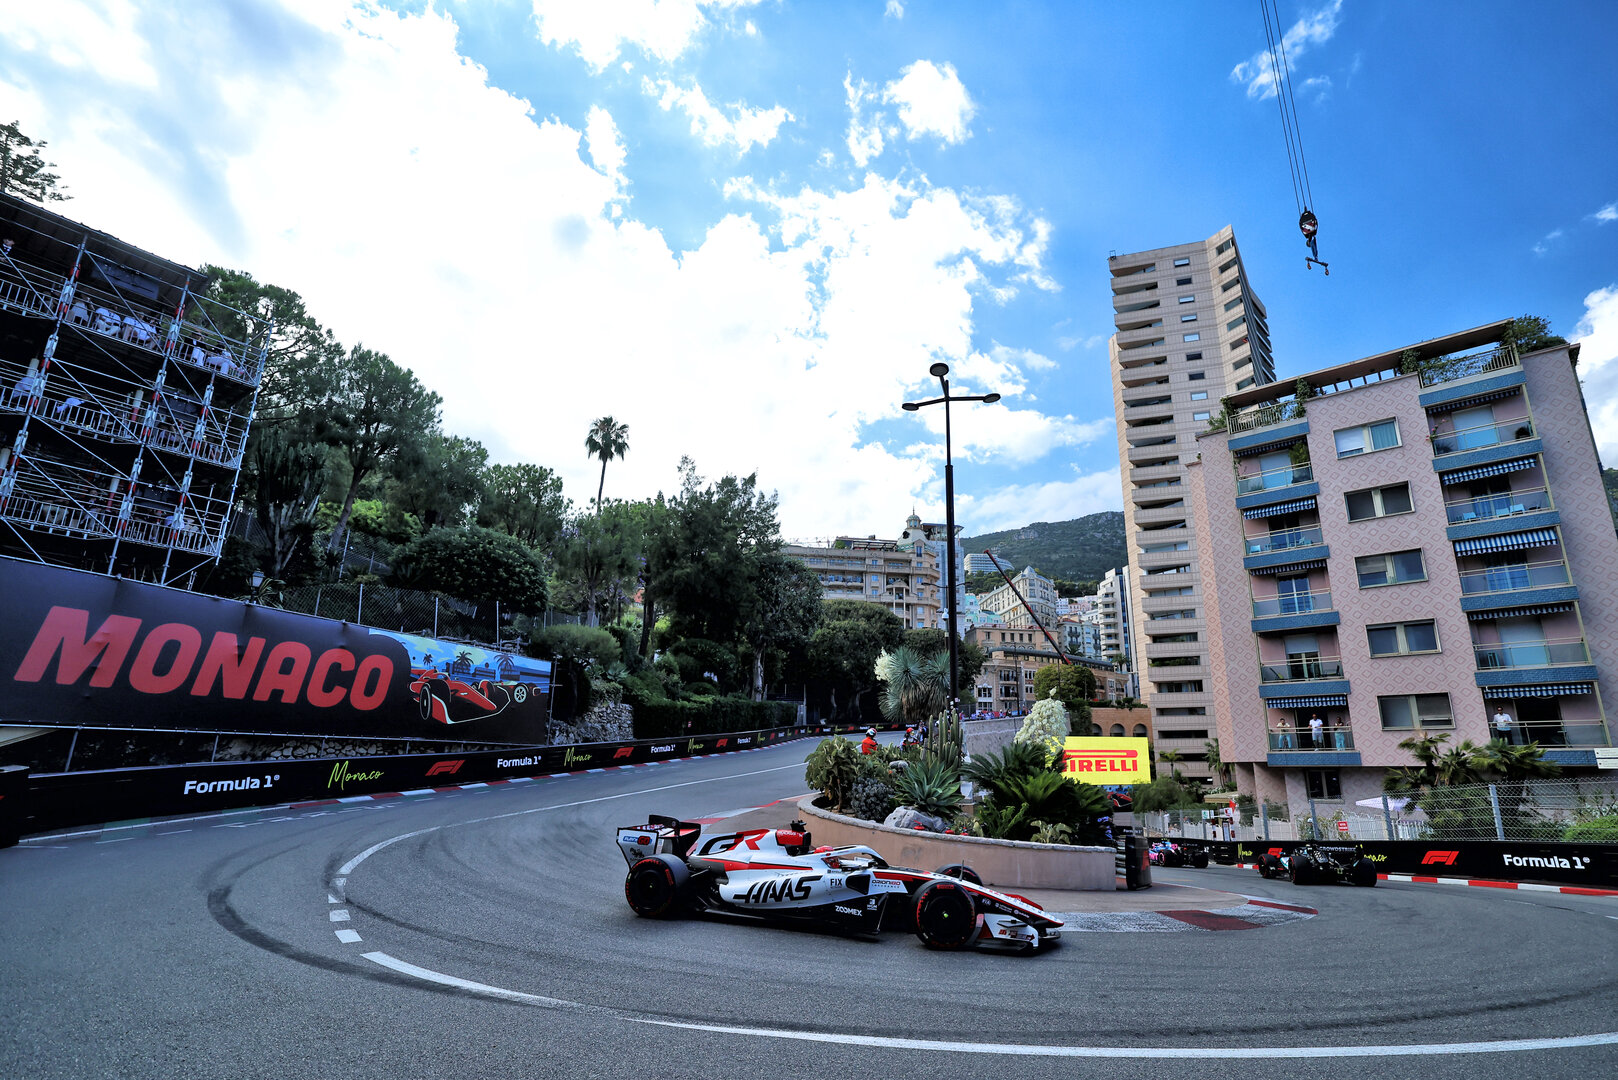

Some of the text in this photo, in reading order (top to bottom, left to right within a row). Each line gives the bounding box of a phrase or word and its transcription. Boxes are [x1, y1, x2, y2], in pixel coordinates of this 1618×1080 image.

[13, 605, 394, 711] MONACO
[563, 746, 593, 768] Monaco
[613, 747, 634, 759] F1
[650, 745, 670, 754] Formula
[425, 759, 466, 777] F1
[497, 756, 533, 769] Formula
[327, 760, 385, 791] Monaco
[183, 776, 260, 795] Formula
[699, 828, 770, 856] GR
[1421, 850, 1460, 866] F1
[1503, 854, 1571, 869] Formula
[732, 875, 823, 904] HAAS
[830, 878, 843, 887] FIX
[834, 904, 863, 917] ZOOMEX
